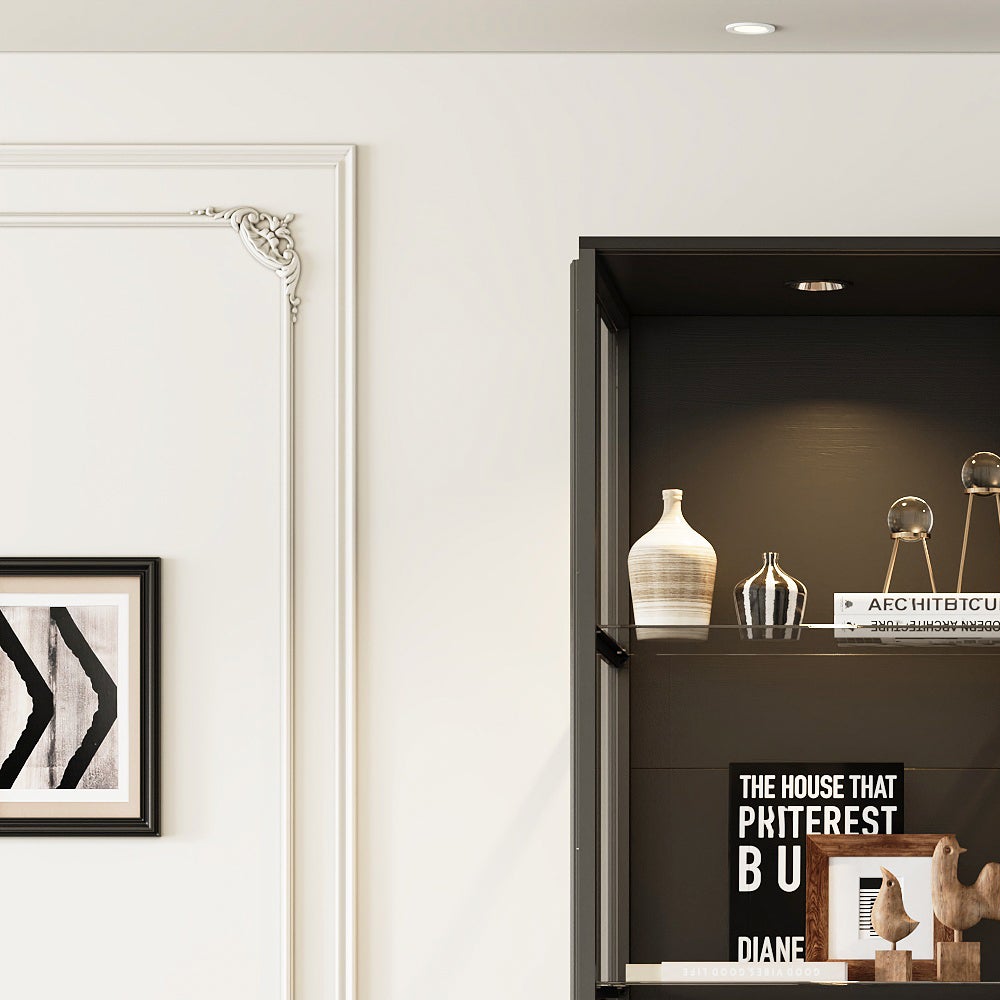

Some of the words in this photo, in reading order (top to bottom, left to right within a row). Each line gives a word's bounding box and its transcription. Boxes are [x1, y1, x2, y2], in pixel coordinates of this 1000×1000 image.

[739, 774, 776, 799] THE
[781, 774, 845, 799] HOUSE
[849, 774, 898, 799] THAT
[738, 936, 805, 962] DIANE
